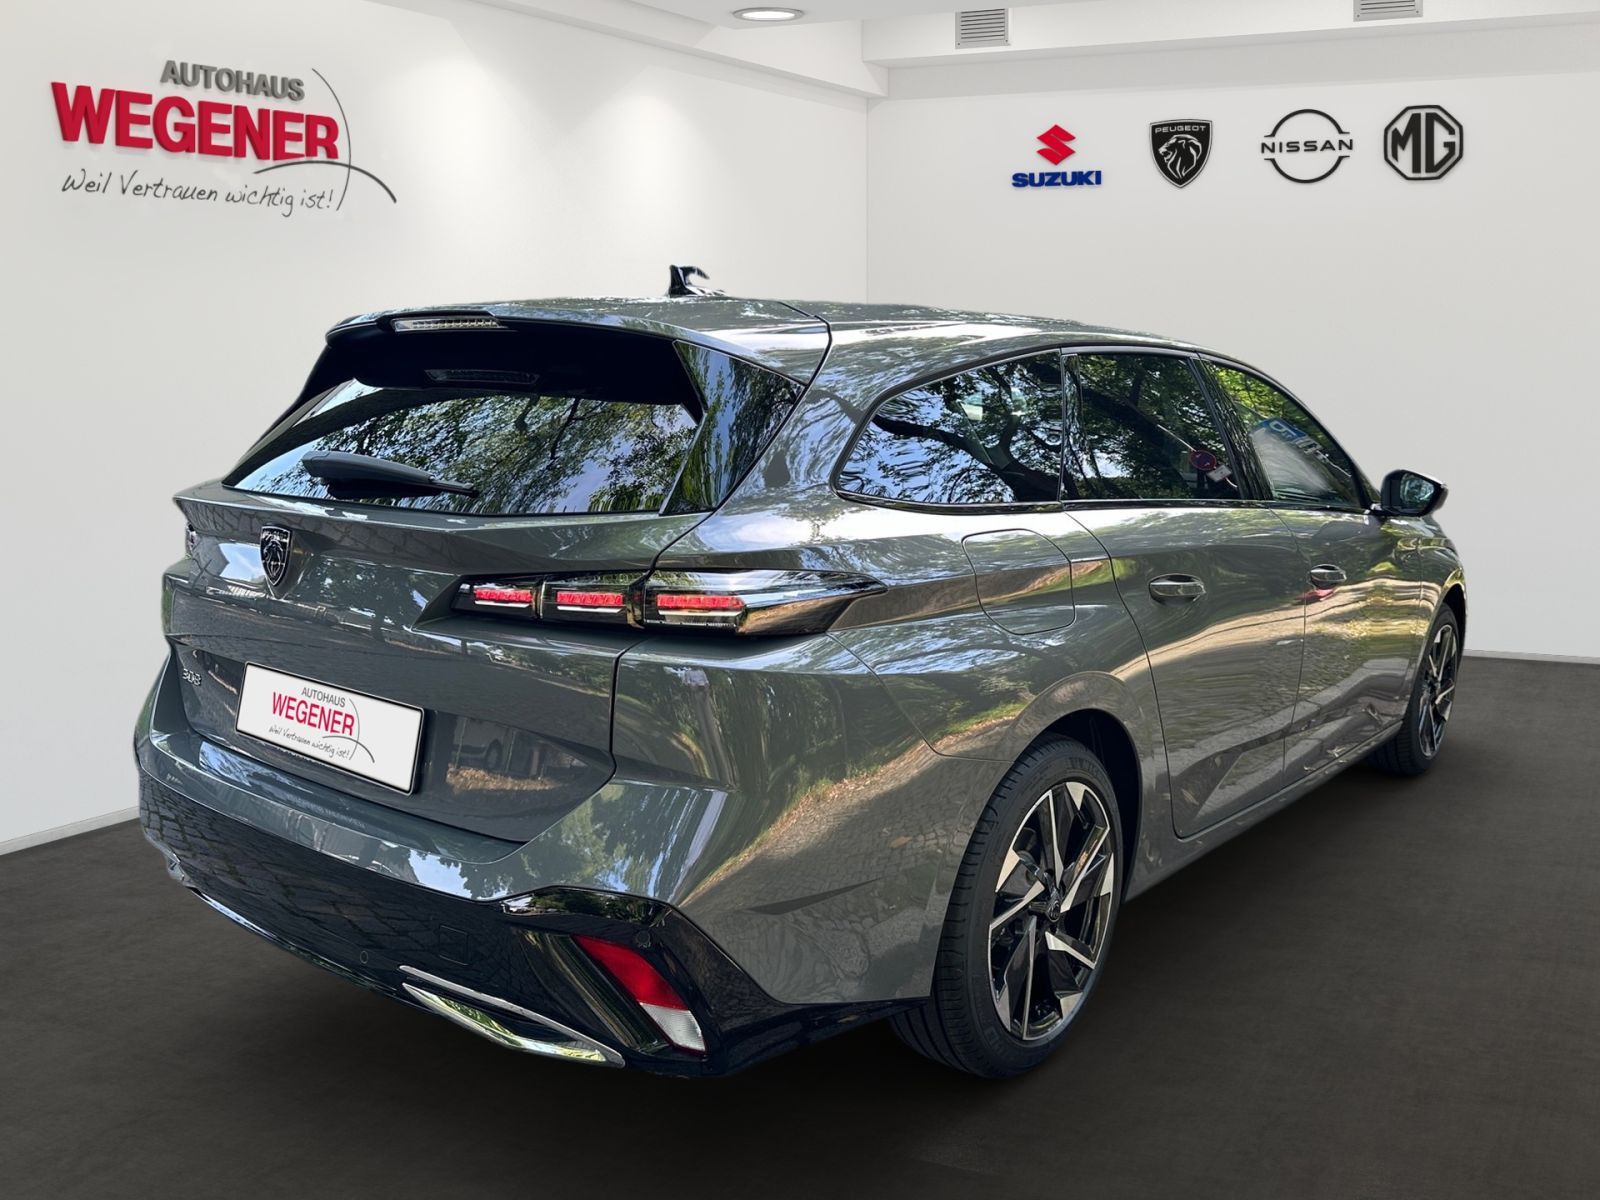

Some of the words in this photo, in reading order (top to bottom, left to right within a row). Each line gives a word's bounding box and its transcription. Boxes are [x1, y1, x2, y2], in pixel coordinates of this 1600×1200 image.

[160, 60, 305, 101] AUTOHAUS
[50, 81, 340, 161] WEGENER
[1154, 125, 1206, 134] PEUGEOT
[1261, 138, 1354, 154] NISSAN
[1391, 111, 1457, 175] MG
[62, 168, 112, 194] Weil
[119, 170, 218, 202] Vertrauen
[225, 184, 294, 217] wichtig
[299, 188, 334, 210] ist!
[1011, 170, 1102, 188] SUZUKI
[272, 691, 355, 736] WEGENER
[301, 687, 346, 708] AUTOHAUS
